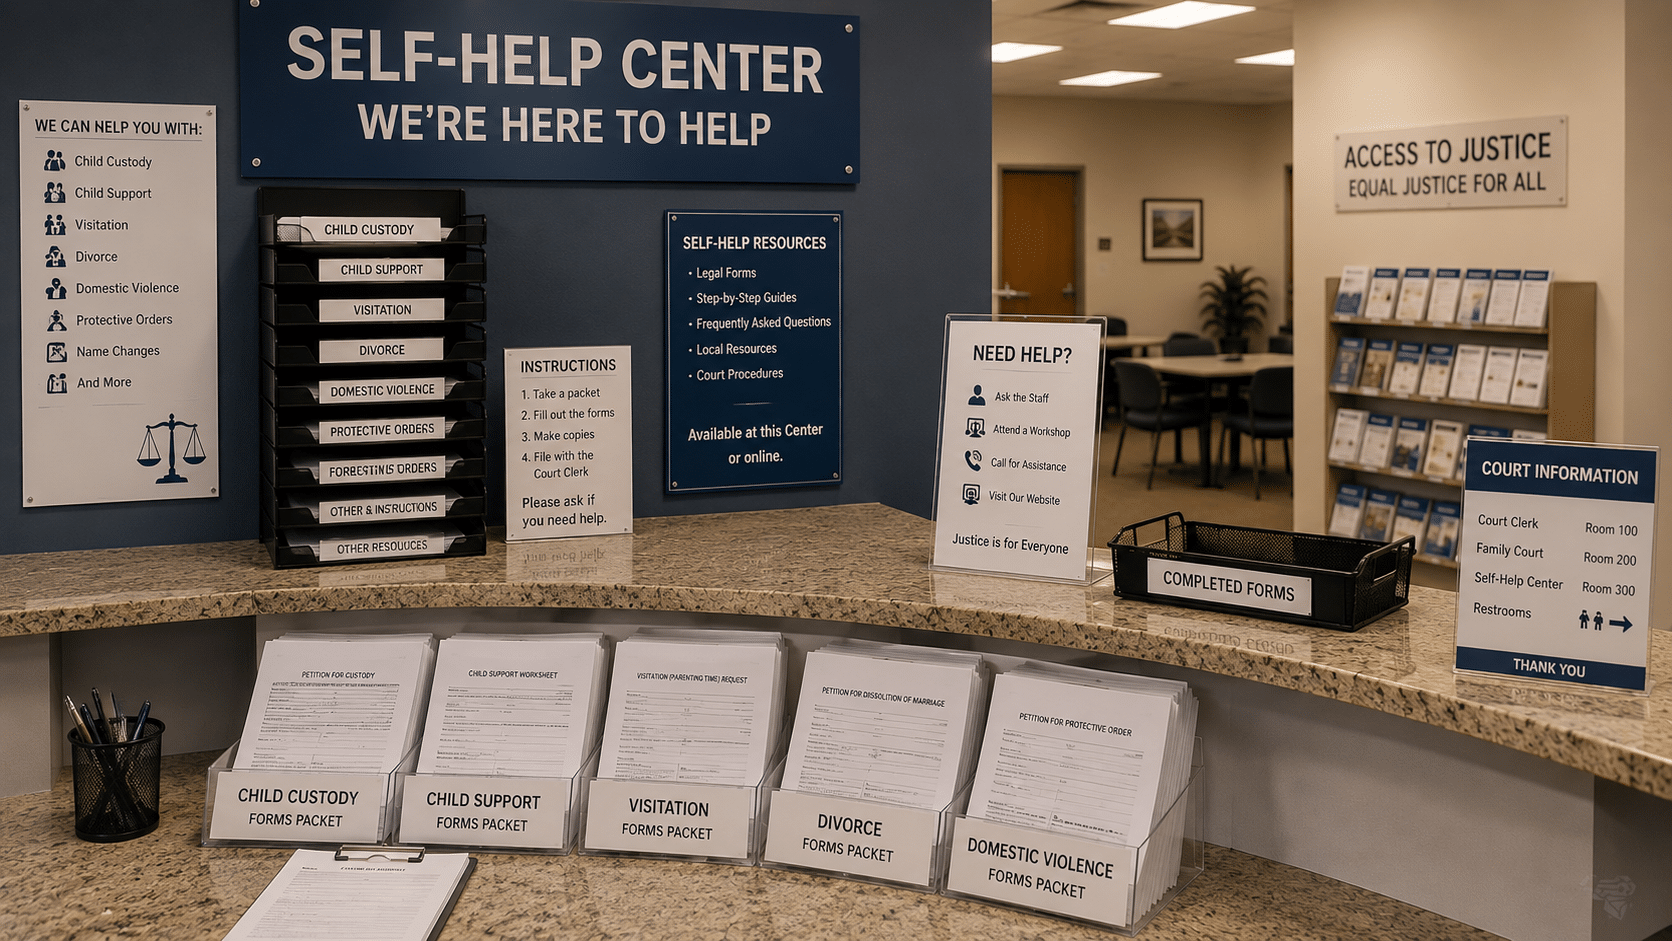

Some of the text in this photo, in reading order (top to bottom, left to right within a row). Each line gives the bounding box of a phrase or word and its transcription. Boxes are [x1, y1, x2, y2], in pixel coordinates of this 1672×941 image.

[288, 26, 823, 93] SELF-HELP CENTER
[35, 119, 56, 132] WE
[61, 120, 89, 132] CAN
[133, 122, 160, 134] YOU
[165, 122, 202, 135] WITH:
[358, 104, 770, 145] WE’RE HERE TO HELP
[1345, 132, 1550, 168] ACCESS TO JUSTICE
[75, 156, 152, 170] Child Custody
[1350, 172, 1546, 198] EQUAL JUSTICE FOR ALL
[75, 187, 151, 200] Child Support
[75, 219, 128, 230] Visitation
[325, 224, 414, 235] CHILD CUSTODY
[684, 236, 826, 249] SELF-HELP RESOURCES
[76, 251, 117, 262] Divorce
[341, 265, 423, 275] CHILD SUPPORT
[697, 267, 756, 280] Legal Forms
[77, 282, 179, 293] Domestic Violence
[697, 292, 796, 305] Step-by-Step Guides
[354, 305, 411, 315] VISITATION
[77, 314, 172, 325] Protective Orders
[697, 316, 831, 331] Frequently Asked Questions
[77, 346, 159, 358] Name Changes
[360, 345, 405, 355] DIVORCE
[697, 344, 777, 355] Local Resources
[974, 345, 1072, 363] NEED HELP?
[522, 359, 615, 372] INSTRUCTIONS
[697, 368, 783, 380] Court Procedures
[78, 377, 131, 388] And More
[331, 384, 434, 396] DOMESTIC VIOLENCE
[522, 390, 529, 399] 1.
[533, 389, 556, 399] Take
[568, 388, 600, 400] packet
[995, 392, 1049, 403] Ask the Staff
[522, 408, 614, 420] 2. Fill out the forms
[331, 425, 390, 436] PROTECTIVE
[522, 429, 594, 442] 3. Make copies
[688, 424, 823, 440] Available at this Center
[993, 425, 1020, 434] Attend
[1030, 427, 1070, 439] Workshop
[522, 450, 593, 462] 4. File with the
[729, 450, 782, 464] or online.
[991, 458, 1066, 471] Call for Assistance
[534, 467, 588, 478] Court Clerk
[1482, 461, 1638, 484] COURT INFORMATION
[523, 494, 595, 508] Please ask if
[989, 491, 1060, 505] Visit Our Website
[331, 506, 362, 516] OTHER
[523, 513, 606, 529] you need help.
[1479, 514, 1637, 536] Court Clerk Room 100
[338, 544, 369, 554] OTHER
[953, 534, 1068, 555] Justice is for Everyone
[1477, 543, 1636, 566] Family Court Room 200
[1162, 571, 1294, 601] COMPLETED FORMS
[1475, 572, 1635, 596] Self-Help Center Room 300
[1474, 602, 1531, 618] Restrooms
[469, 669, 487, 677] CHILD
[1514, 658, 1585, 677] THANK YOU
[1020, 713, 1049, 723] PETITION
[1065, 720, 1106, 732] PROTECTIVE
[1108, 727, 1132, 736] ORDER
[239, 788, 358, 805] CHILD CUSTODY
[427, 792, 540, 809] CHILD SUPPORT
[630, 798, 708, 816] VISITATION
[249, 813, 343, 826] FORMS PACKET
[437, 817, 527, 831] FORMS PACKET
[818, 814, 882, 836] DIVORCE
[623, 823, 712, 839] FORMS PACKET
[803, 838, 893, 862] FORMS PACKET
[968, 838, 1113, 880] DOMESTIC VIOLENCE
[989, 868, 1085, 899] FORMS PACKET
